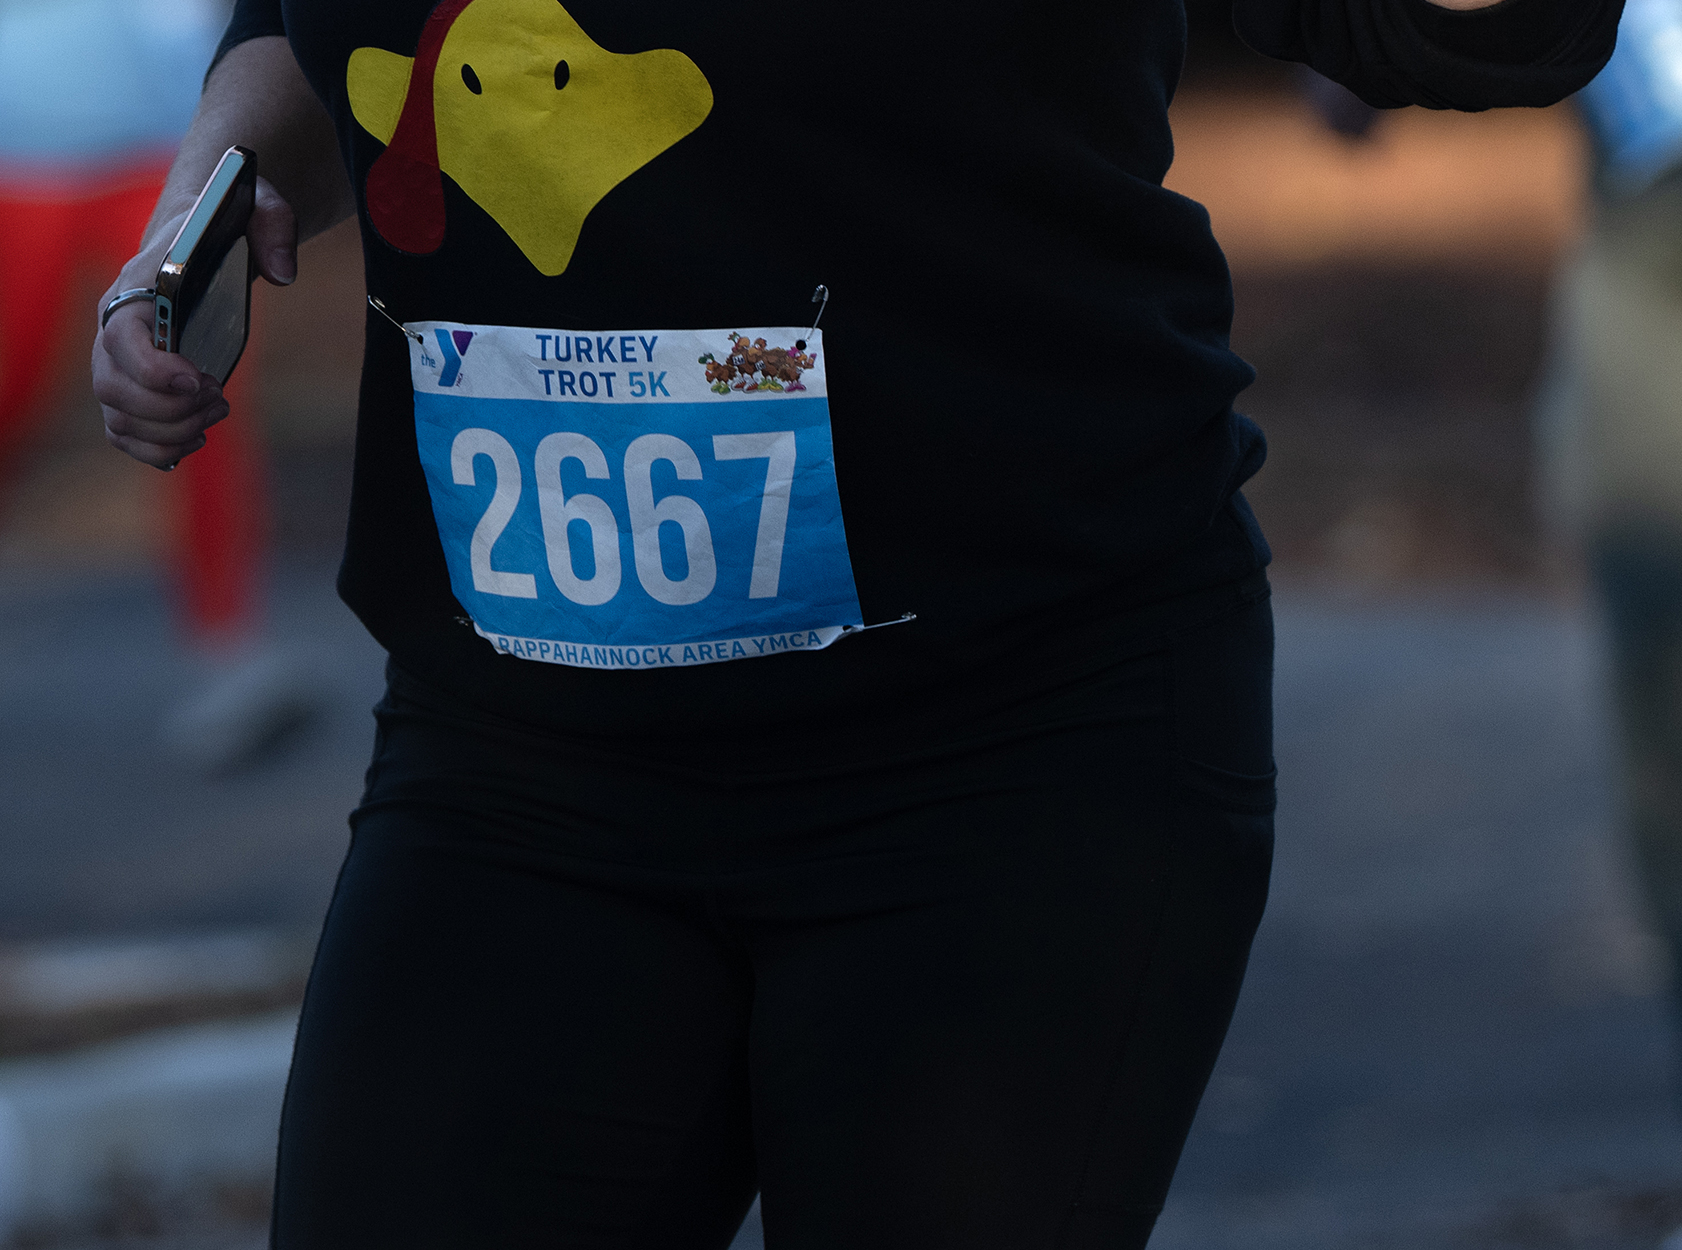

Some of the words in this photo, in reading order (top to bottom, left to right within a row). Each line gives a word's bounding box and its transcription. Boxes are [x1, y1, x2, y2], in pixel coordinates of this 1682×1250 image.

[421, 354, 436, 368] the
[535, 334, 658, 363] TURKEY
[538, 369, 616, 398] TROT
[628, 371, 671, 398] 5K
[450, 427, 797, 607] 2667
[498, 636, 674, 667] RAPPAHANNOCK
[682, 640, 747, 664] AREA
[752, 631, 822, 655] YMCA
